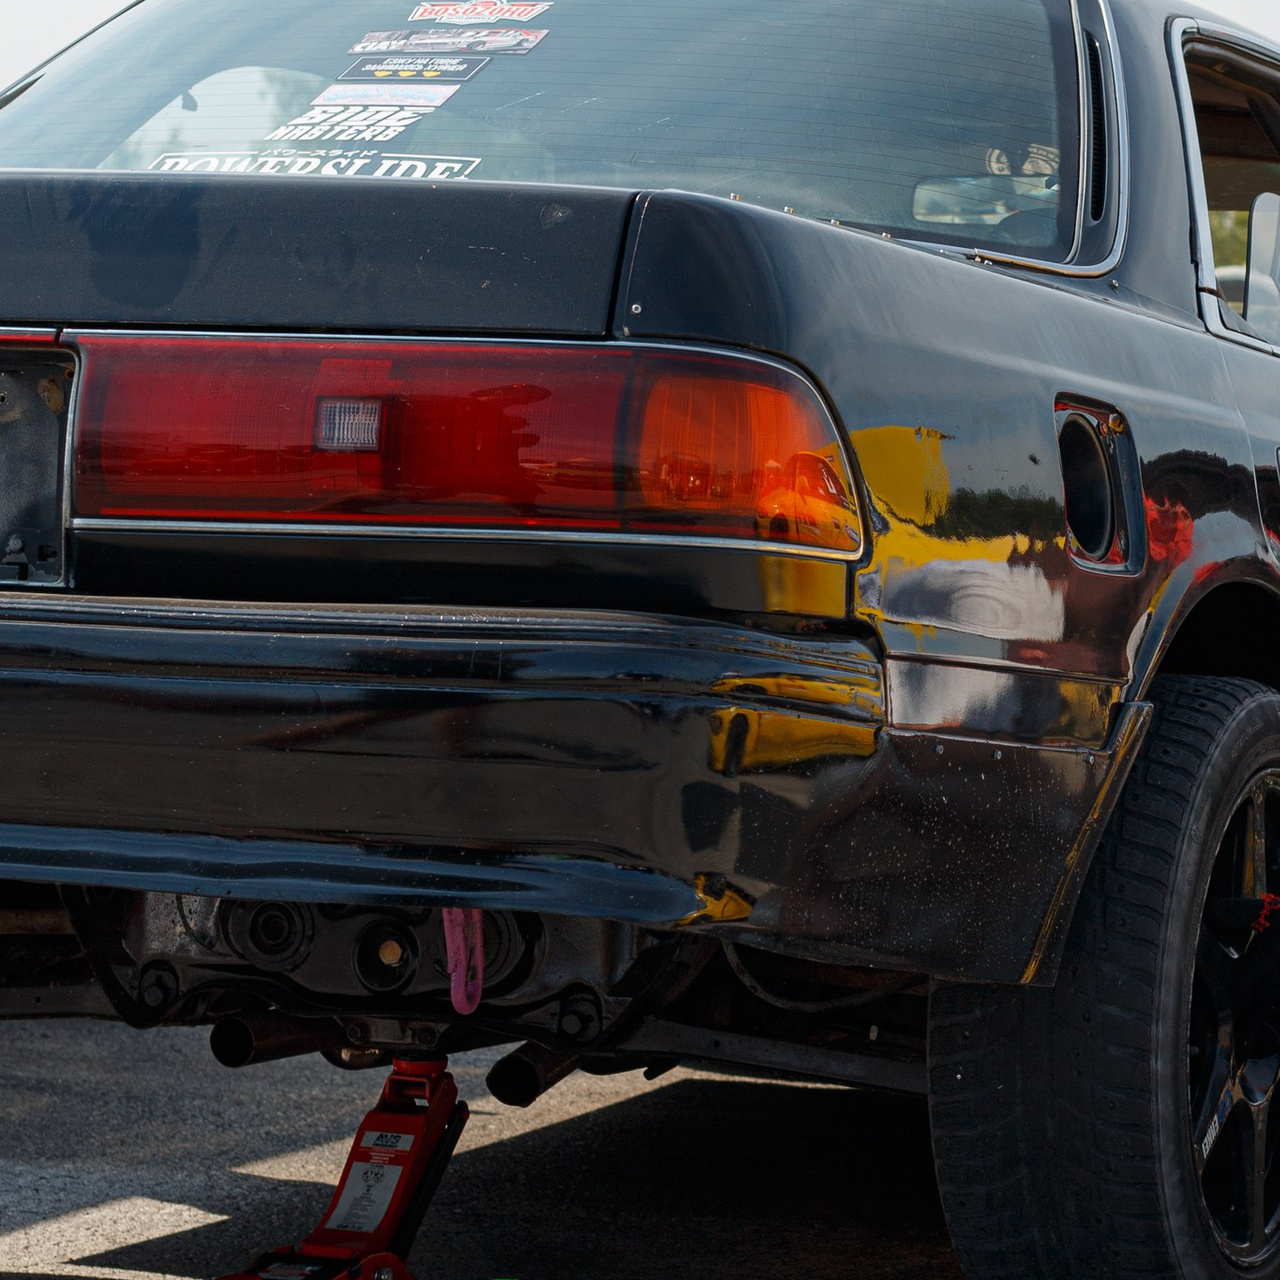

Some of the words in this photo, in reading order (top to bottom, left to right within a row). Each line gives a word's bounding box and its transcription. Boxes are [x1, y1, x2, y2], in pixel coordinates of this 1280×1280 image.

[286, 106, 435, 126] SIDE
[263, 125, 406, 141] MASTERS
[260, 149, 379, 157] パワースライド
[374, 1133, 402, 1144] AVS
[1201, 1113, 1220, 1159] ENKEI
